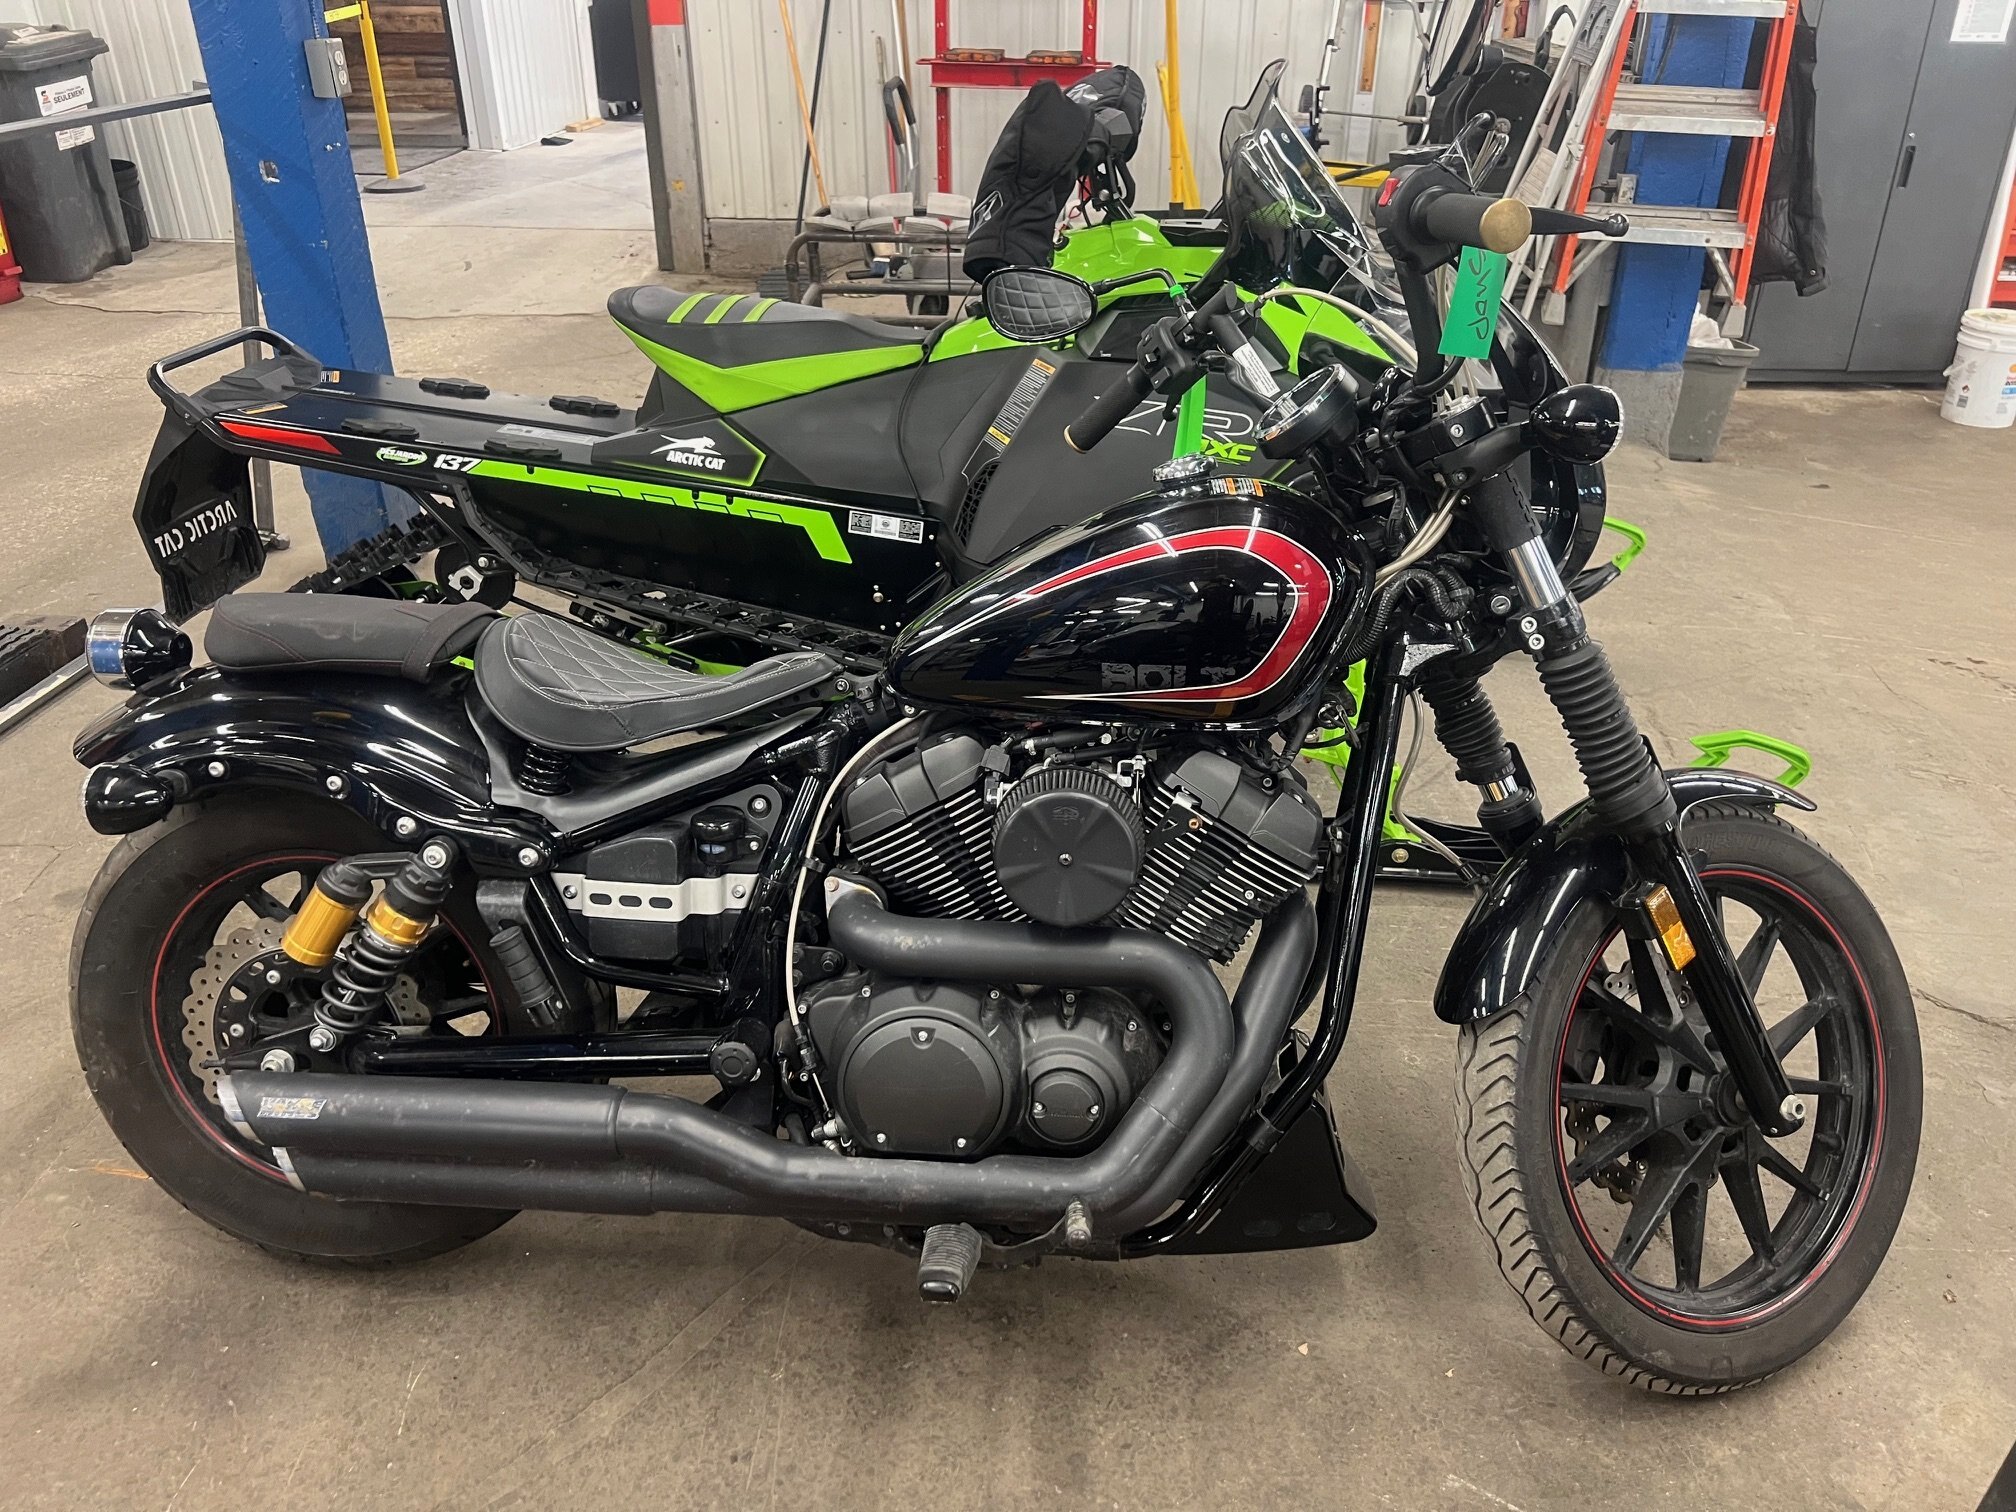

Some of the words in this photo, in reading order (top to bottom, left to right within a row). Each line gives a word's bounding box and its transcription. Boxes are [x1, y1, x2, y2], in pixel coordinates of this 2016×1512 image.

[53, 88, 85, 104] SEULEMENT
[433, 453, 482, 473] 137
[666, 450, 704, 467] ARCTIC
[704, 456, 726, 471] CAT
